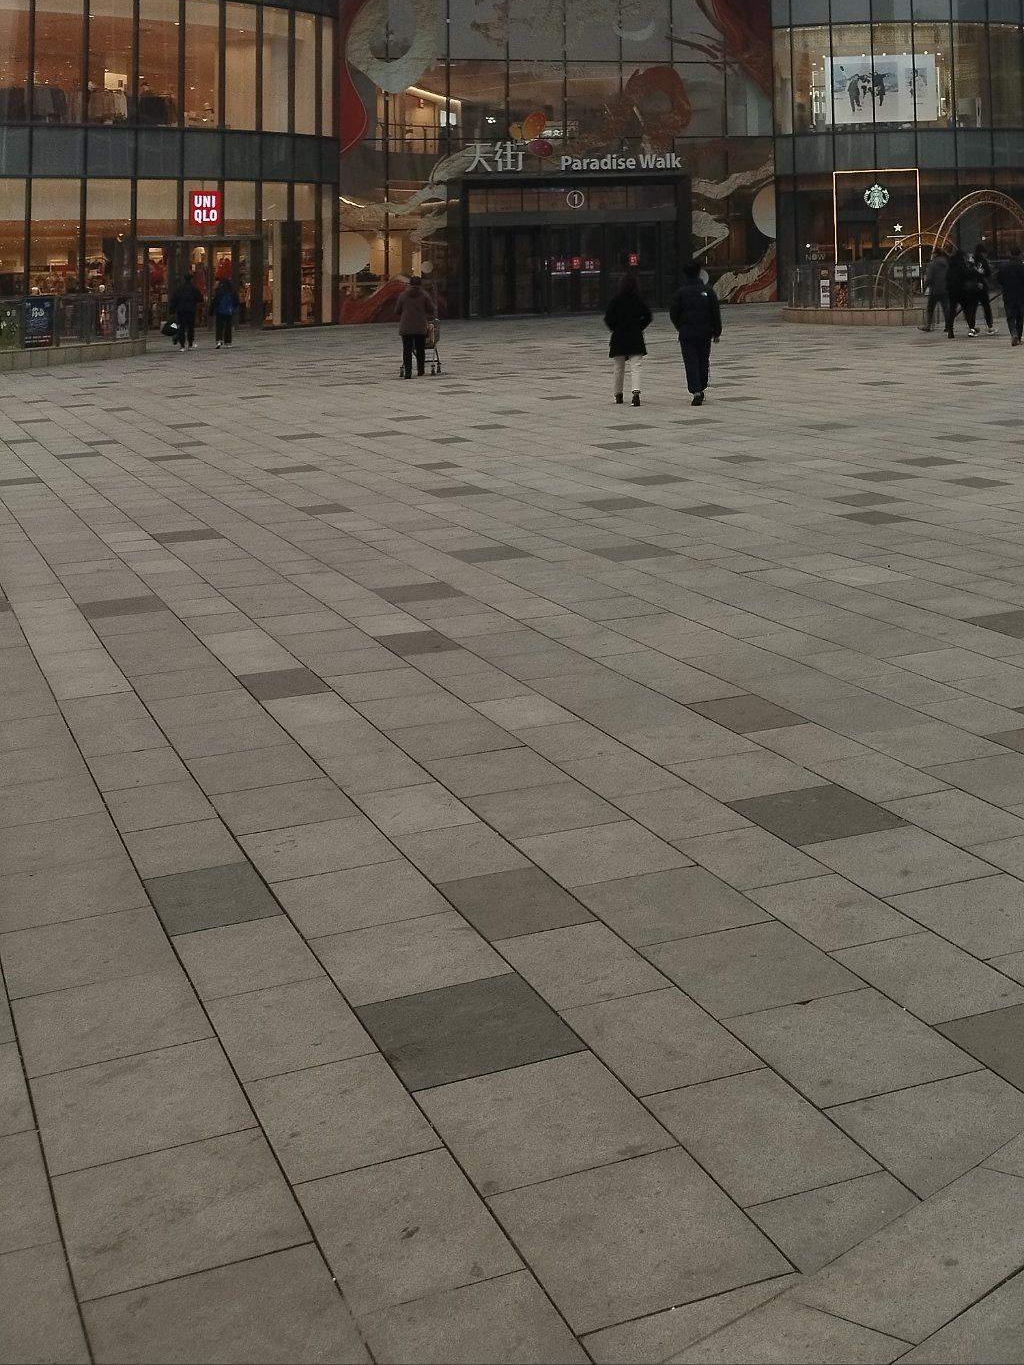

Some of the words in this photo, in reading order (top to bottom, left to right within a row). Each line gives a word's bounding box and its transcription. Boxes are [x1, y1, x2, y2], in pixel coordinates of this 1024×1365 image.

[465, 141, 525, 172] 天街
[560, 153, 636, 171] Paradise
[638, 153, 682, 169] Walk
[194, 195, 216, 208] UNI
[194, 209, 218, 224] QLO
